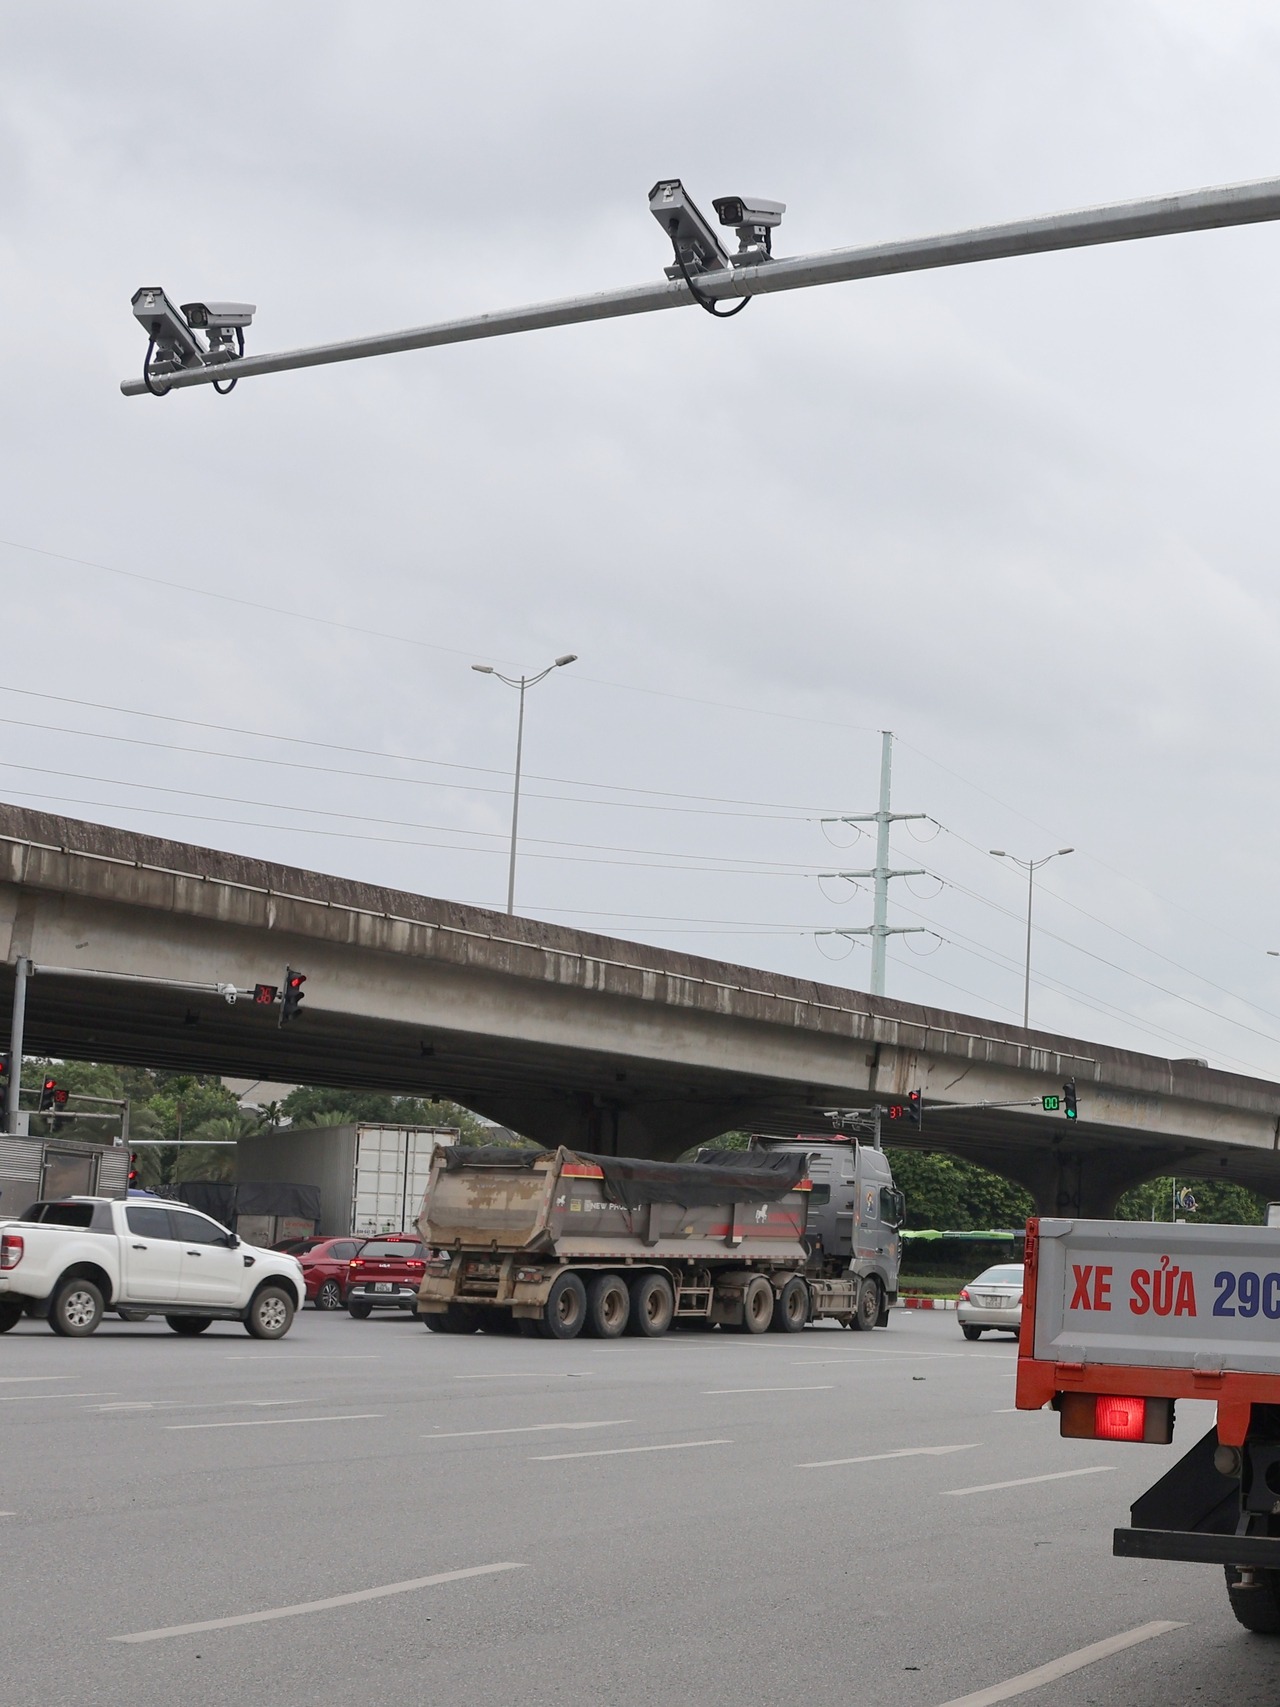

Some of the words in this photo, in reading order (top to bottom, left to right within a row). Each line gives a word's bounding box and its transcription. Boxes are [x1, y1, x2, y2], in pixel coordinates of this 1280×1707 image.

[890, 1106, 903, 1119] 37
[591, 1202, 608, 1210] NEW
[1069, 1264, 1113, 1311] XE
[1129, 1255, 1197, 1317] SỬA
